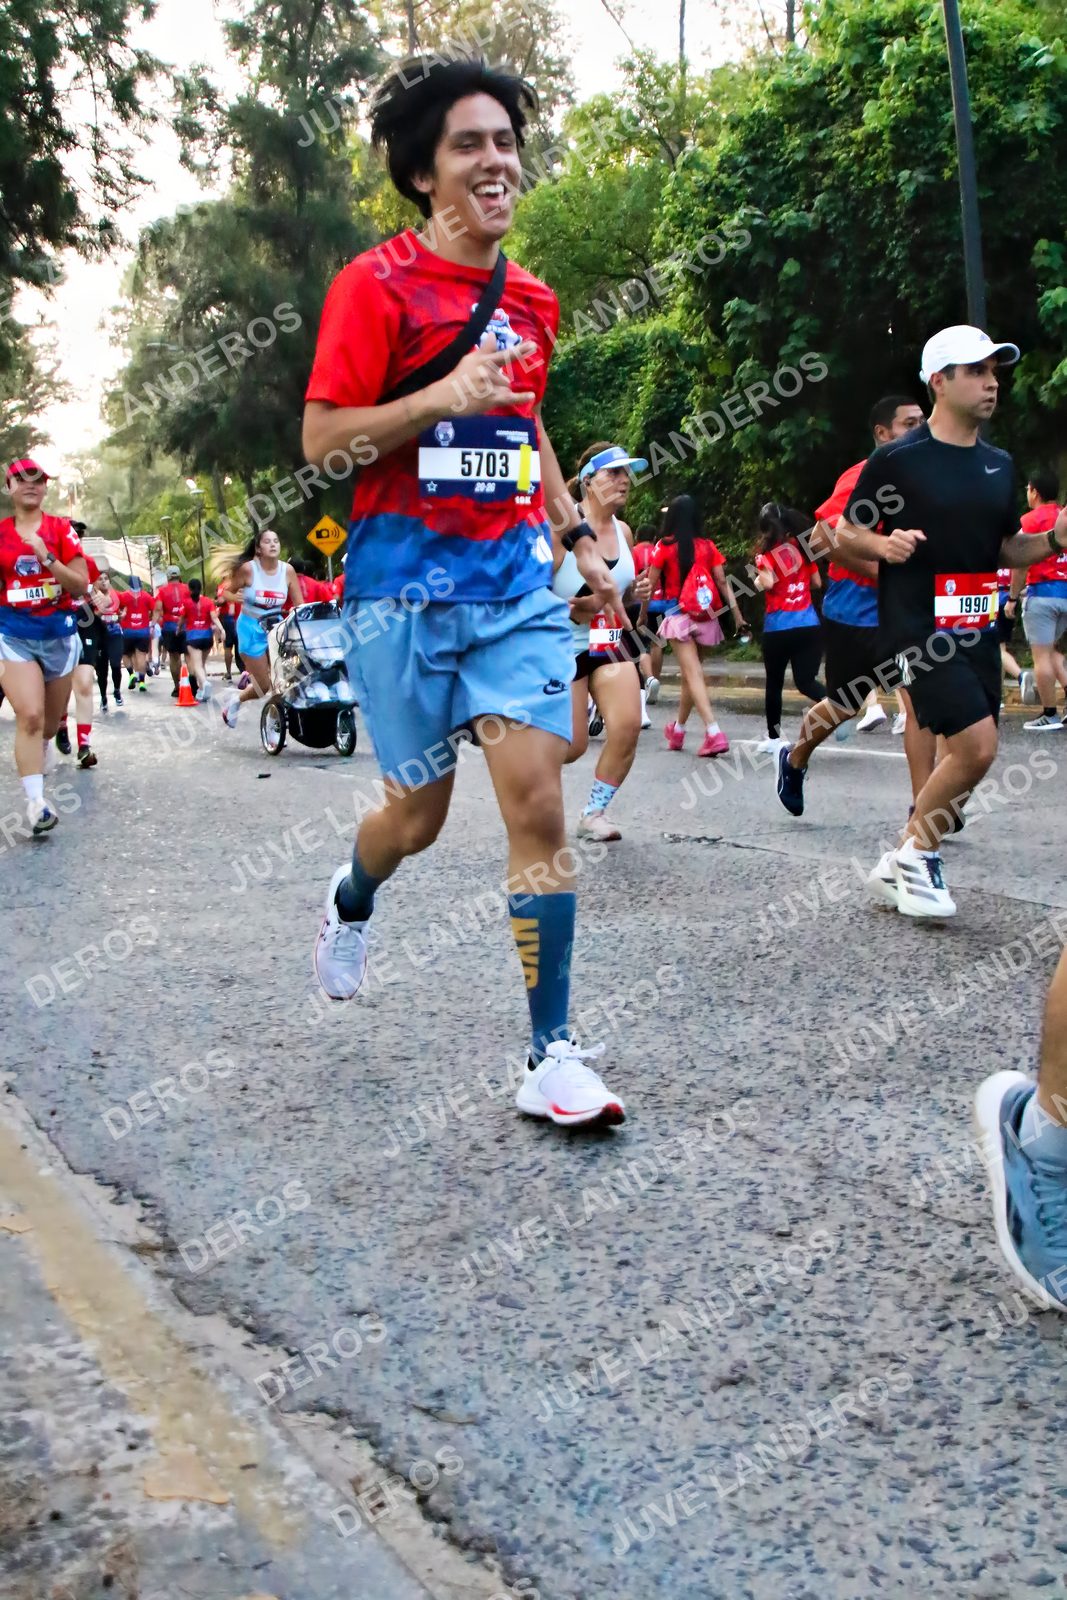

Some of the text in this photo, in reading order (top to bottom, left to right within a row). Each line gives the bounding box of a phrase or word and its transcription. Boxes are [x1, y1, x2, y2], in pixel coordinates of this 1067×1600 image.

[461, 451, 509, 477] 5703
[25, 588, 45, 599] 1441
[959, 597, 989, 613] 1990
